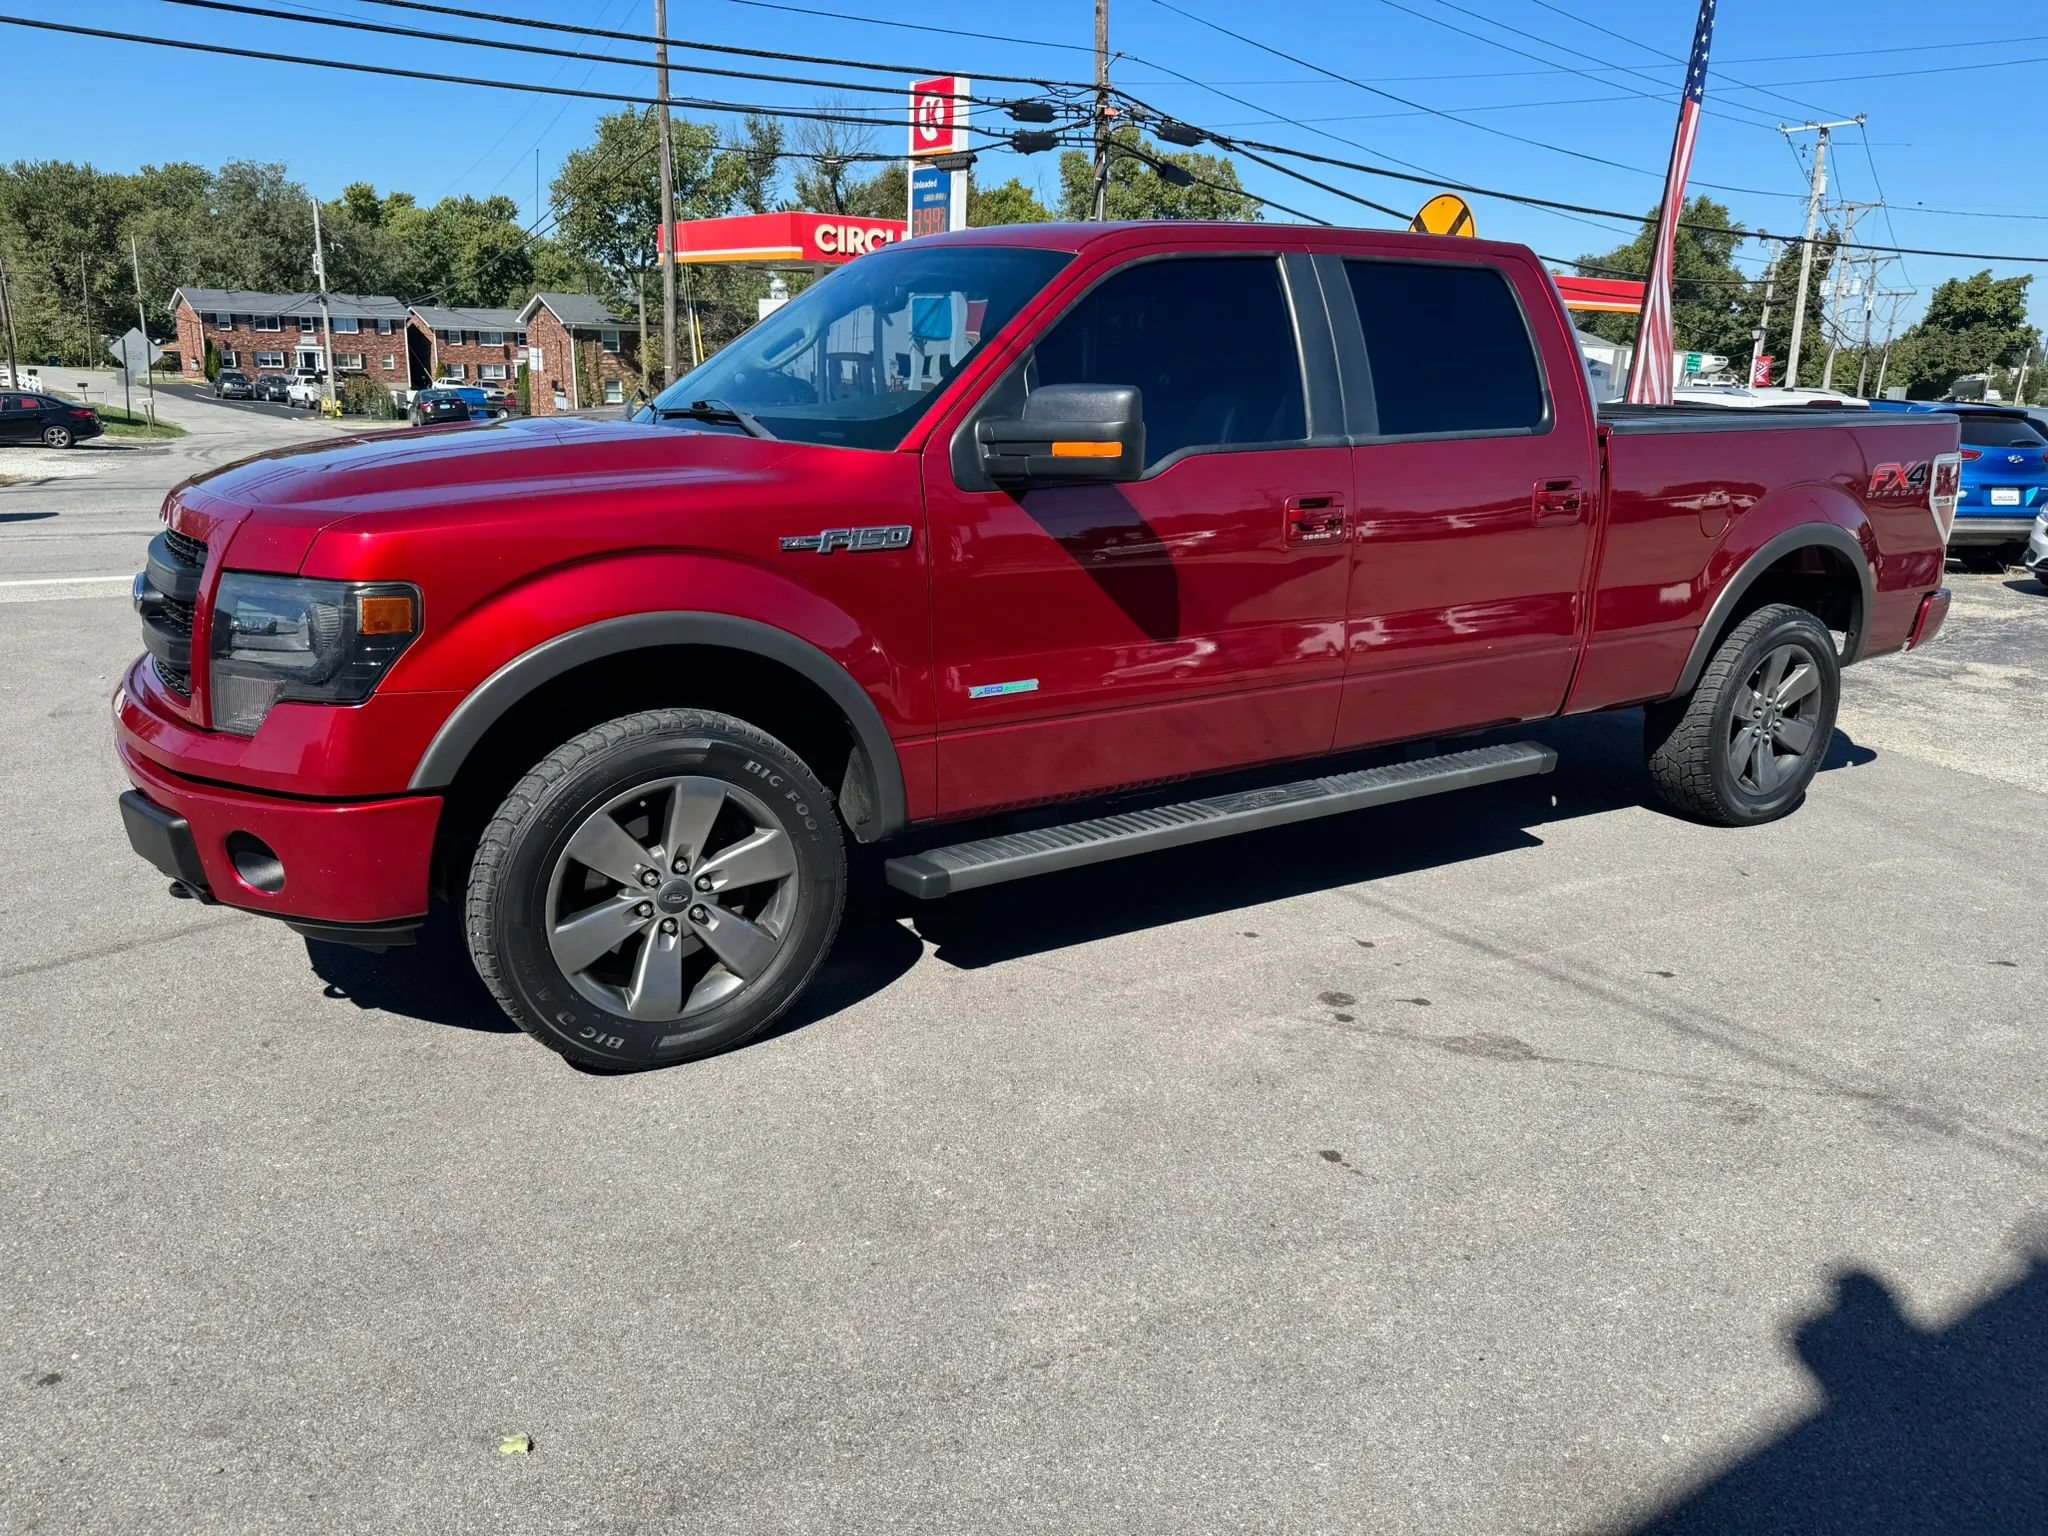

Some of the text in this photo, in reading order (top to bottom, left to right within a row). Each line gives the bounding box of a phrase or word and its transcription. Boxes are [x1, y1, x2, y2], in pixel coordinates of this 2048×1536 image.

[913, 178, 937, 190] Unleaded
[815, 223, 908, 255] CIRC
[1868, 460, 1929, 491] FX4
[1866, 489, 1923, 499] OFF ROAD
[817, 525, 913, 554] F-150
[743, 759, 784, 788] BIG
[578, 1025, 625, 1050] BIG
